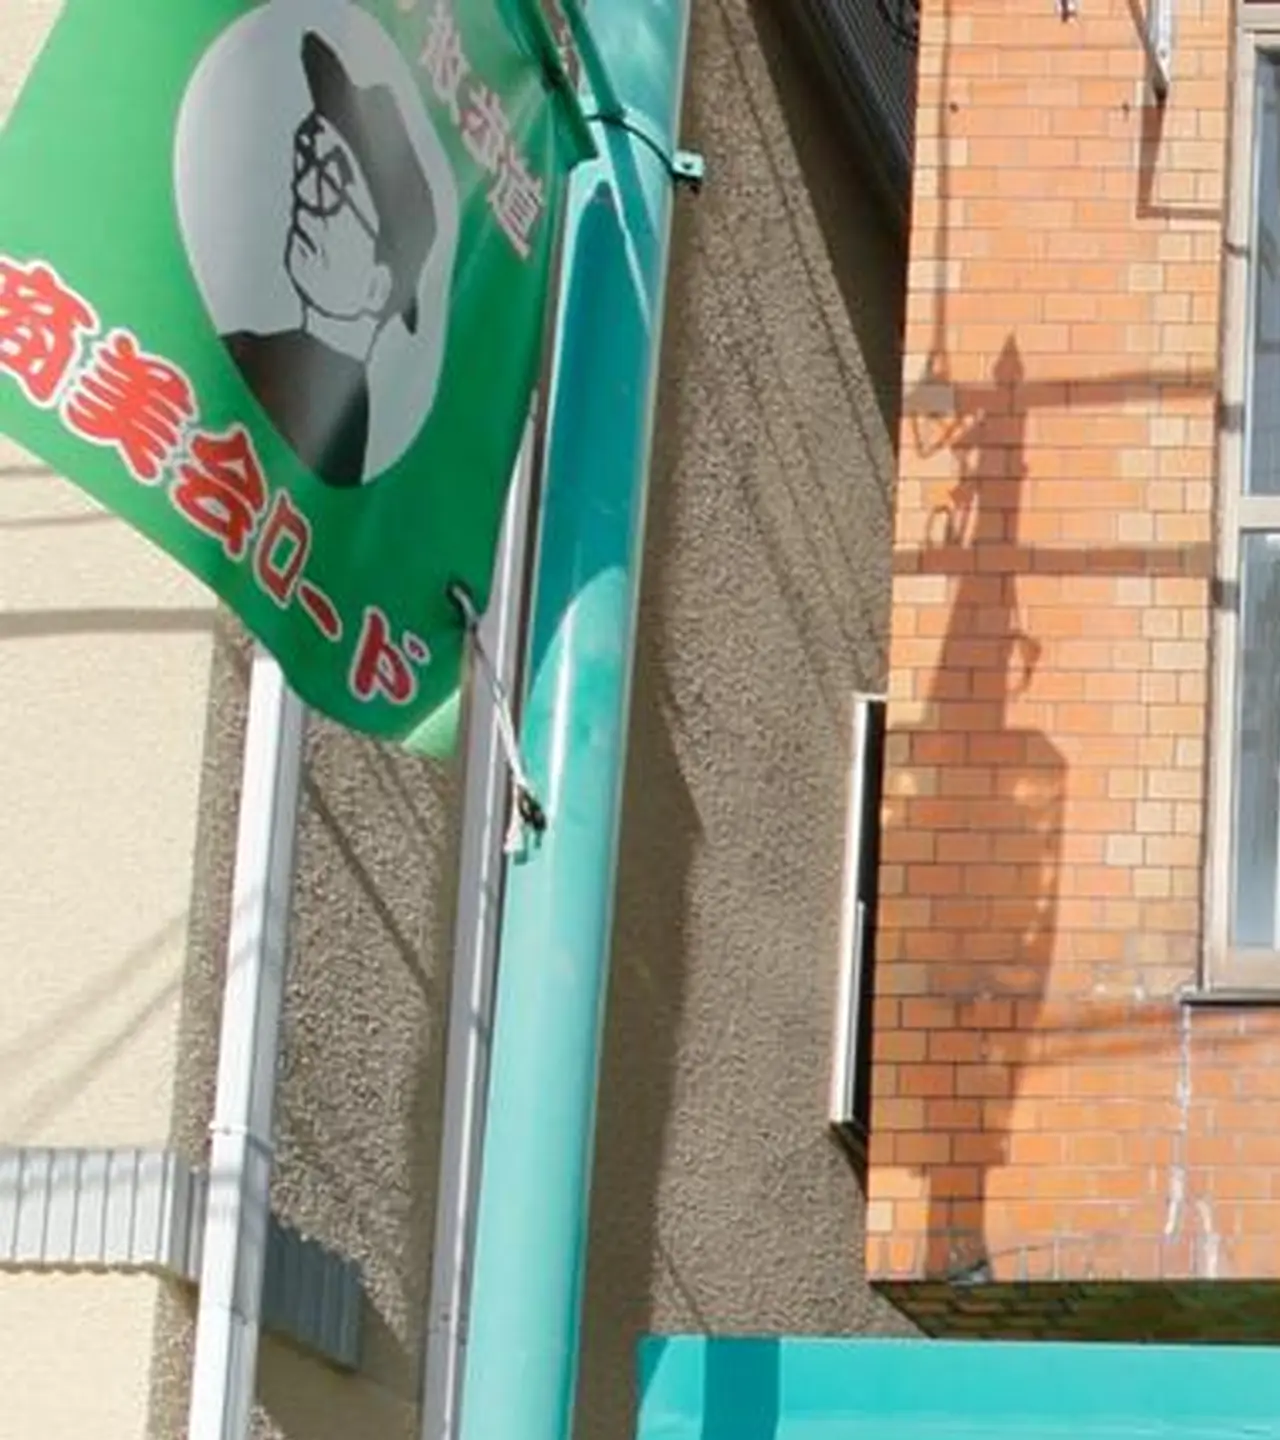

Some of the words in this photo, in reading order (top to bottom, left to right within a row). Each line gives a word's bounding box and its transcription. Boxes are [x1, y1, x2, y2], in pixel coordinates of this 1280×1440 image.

[0, 258, 432, 706] 商美会ロード
